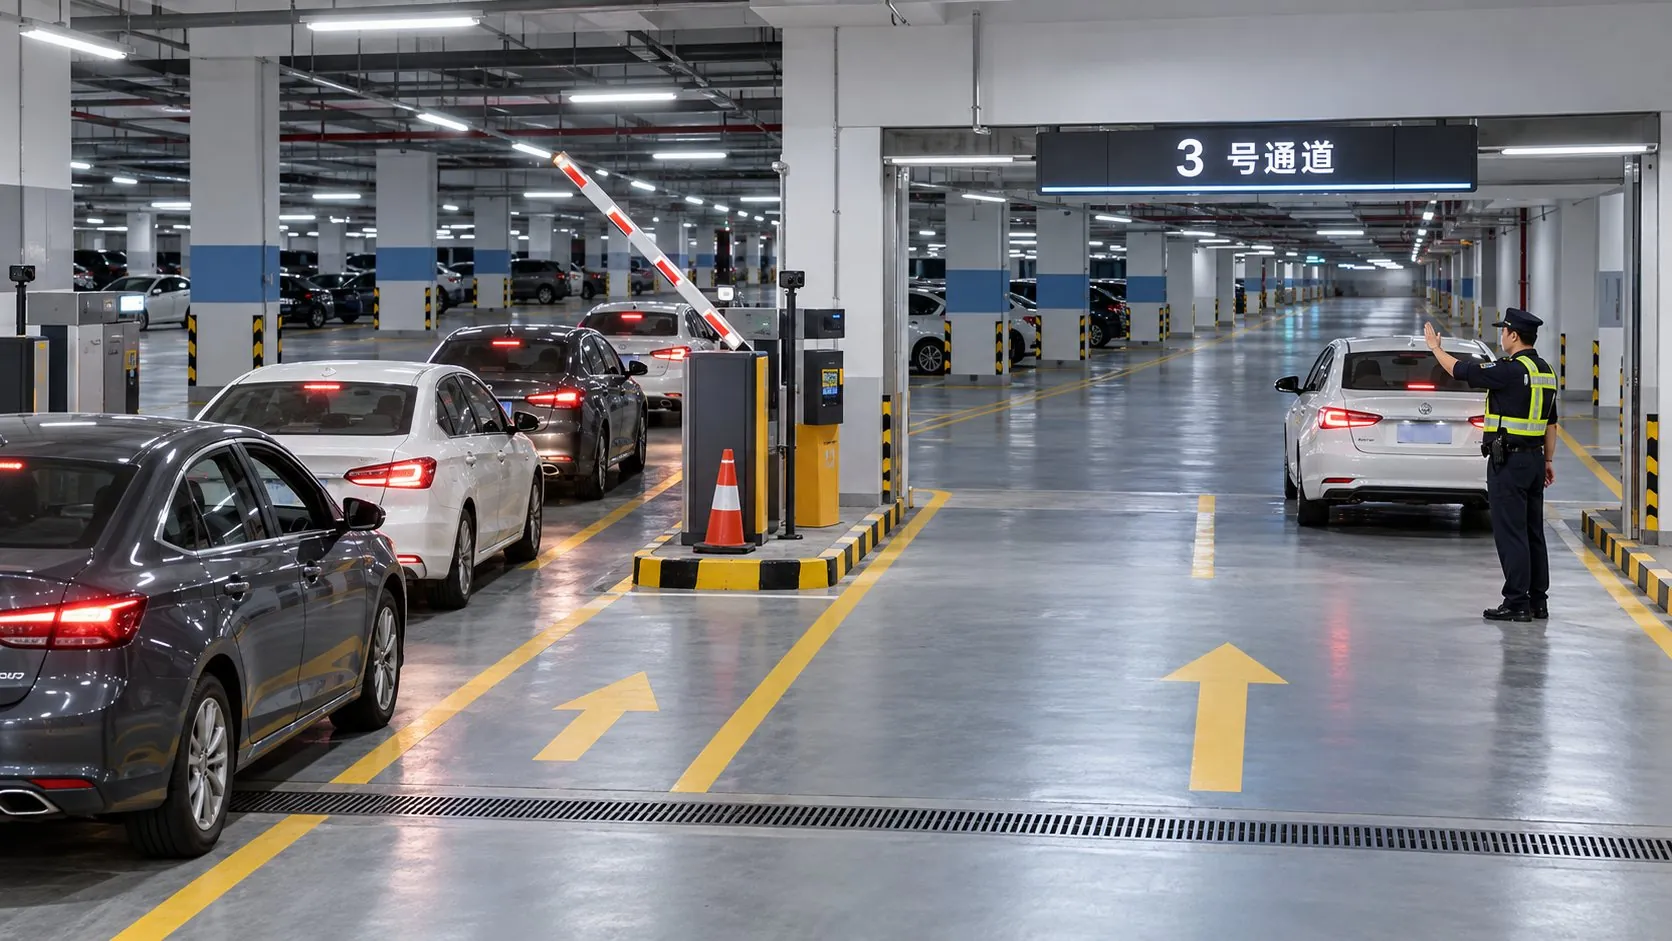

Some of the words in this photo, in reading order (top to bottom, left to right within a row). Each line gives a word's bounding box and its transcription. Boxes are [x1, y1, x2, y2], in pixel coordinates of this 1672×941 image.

[1176, 138, 1204, 178] 3
[1227, 140, 1335, 176] 号通道
